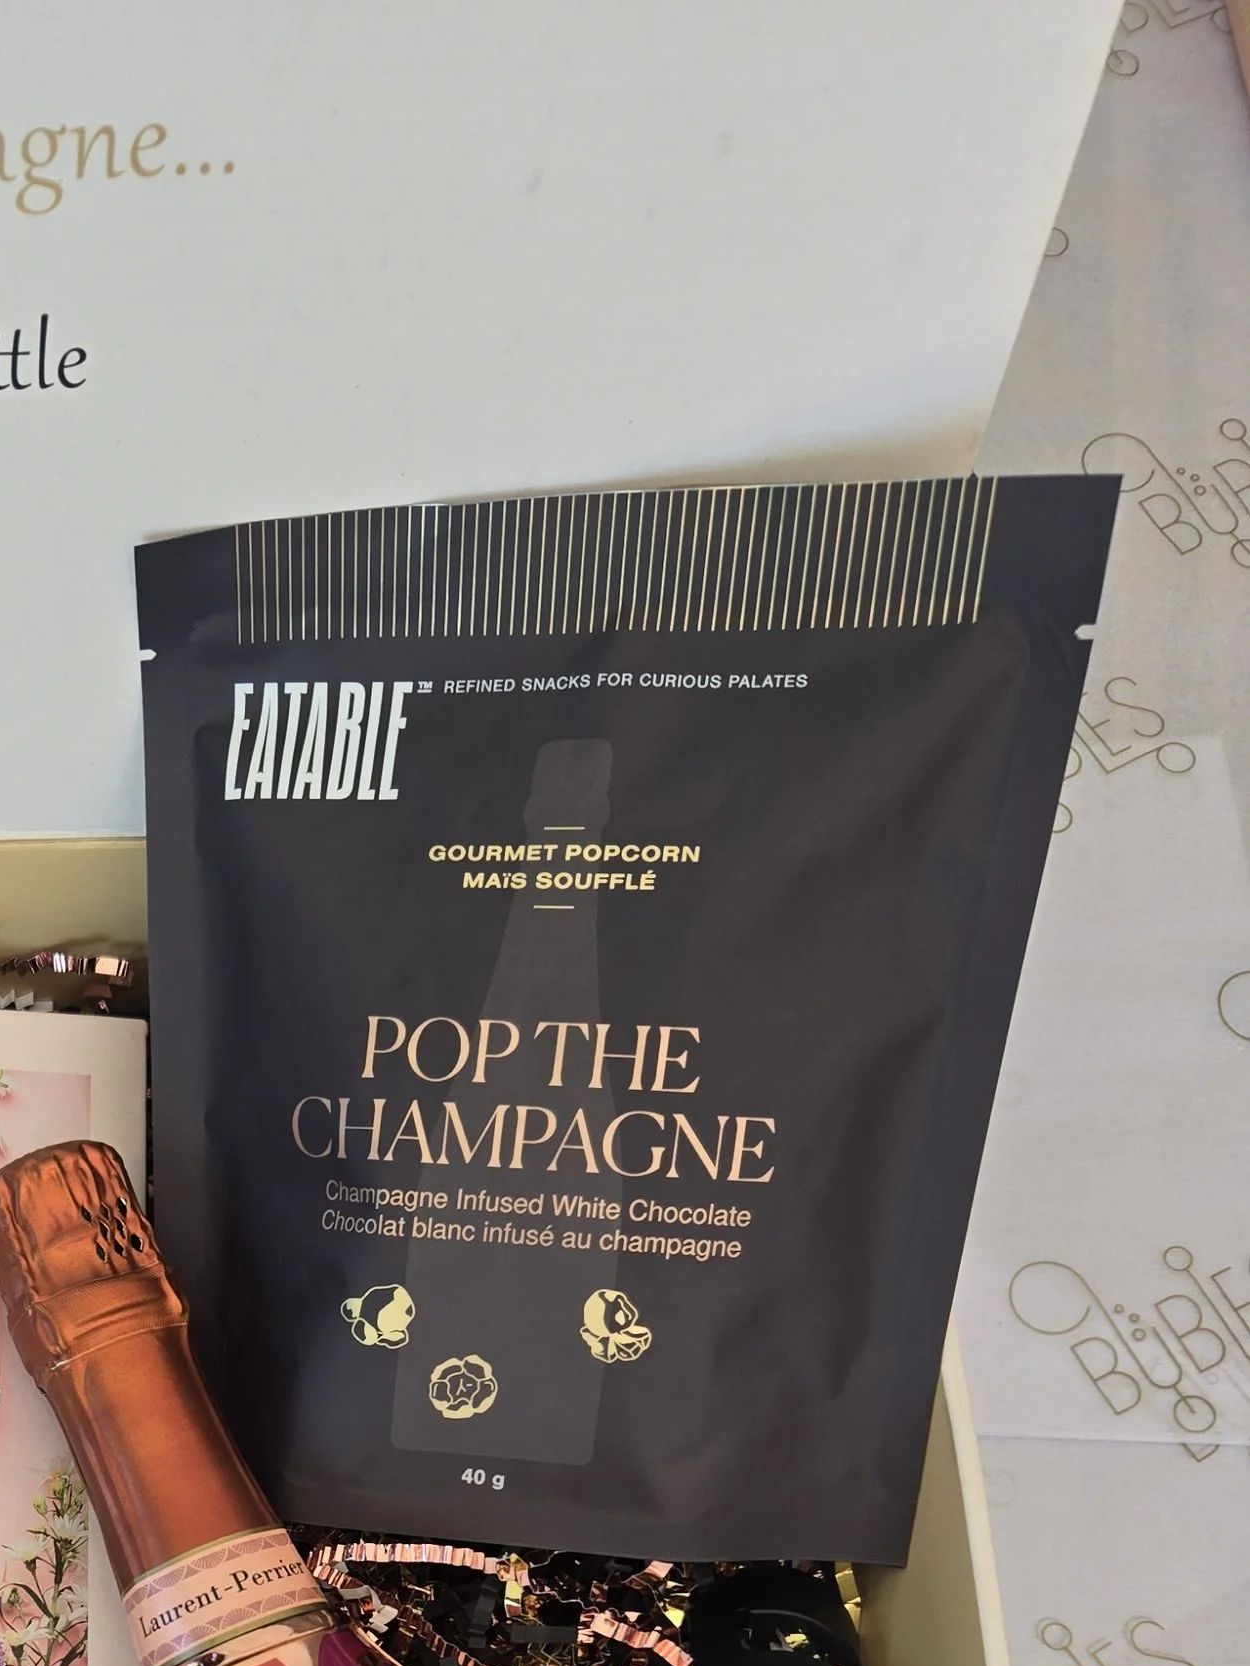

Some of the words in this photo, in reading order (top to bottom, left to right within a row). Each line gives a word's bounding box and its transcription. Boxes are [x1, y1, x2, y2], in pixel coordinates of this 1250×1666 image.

[443, 677, 516, 695] REFINED
[521, 673, 591, 693] SNACKS
[596, 672, 634, 688] FOR
[639, 672, 723, 690] CURIOUS
[727, 673, 809, 690] PALATES
[428, 843, 559, 863] GOURMET
[564, 843, 701, 864] POPCORN
[534, 869, 657, 891] SOUFFLÉ
[360, 1014, 520, 1085] POP
[533, 1020, 701, 1094] THE
[290, 1094, 778, 1184] CHAMPAGNE
[325, 1178, 449, 1212] Champagne
[456, 1188, 545, 1216] Infused
[551, 1193, 621, 1221] White
[628, 1198, 752, 1228] Chocolate
[321, 1208, 406, 1238] Chocolat
[411, 1219, 476, 1242] blanc
[482, 1223, 555, 1247] infusé
[561, 1229, 591, 1249] au
[598, 1229, 742, 1262] champagne
[460, 1467, 487, 1486] 40
[490, 1473, 506, 1491] g
[138, 1559, 306, 1640] Laurent-Perrier
